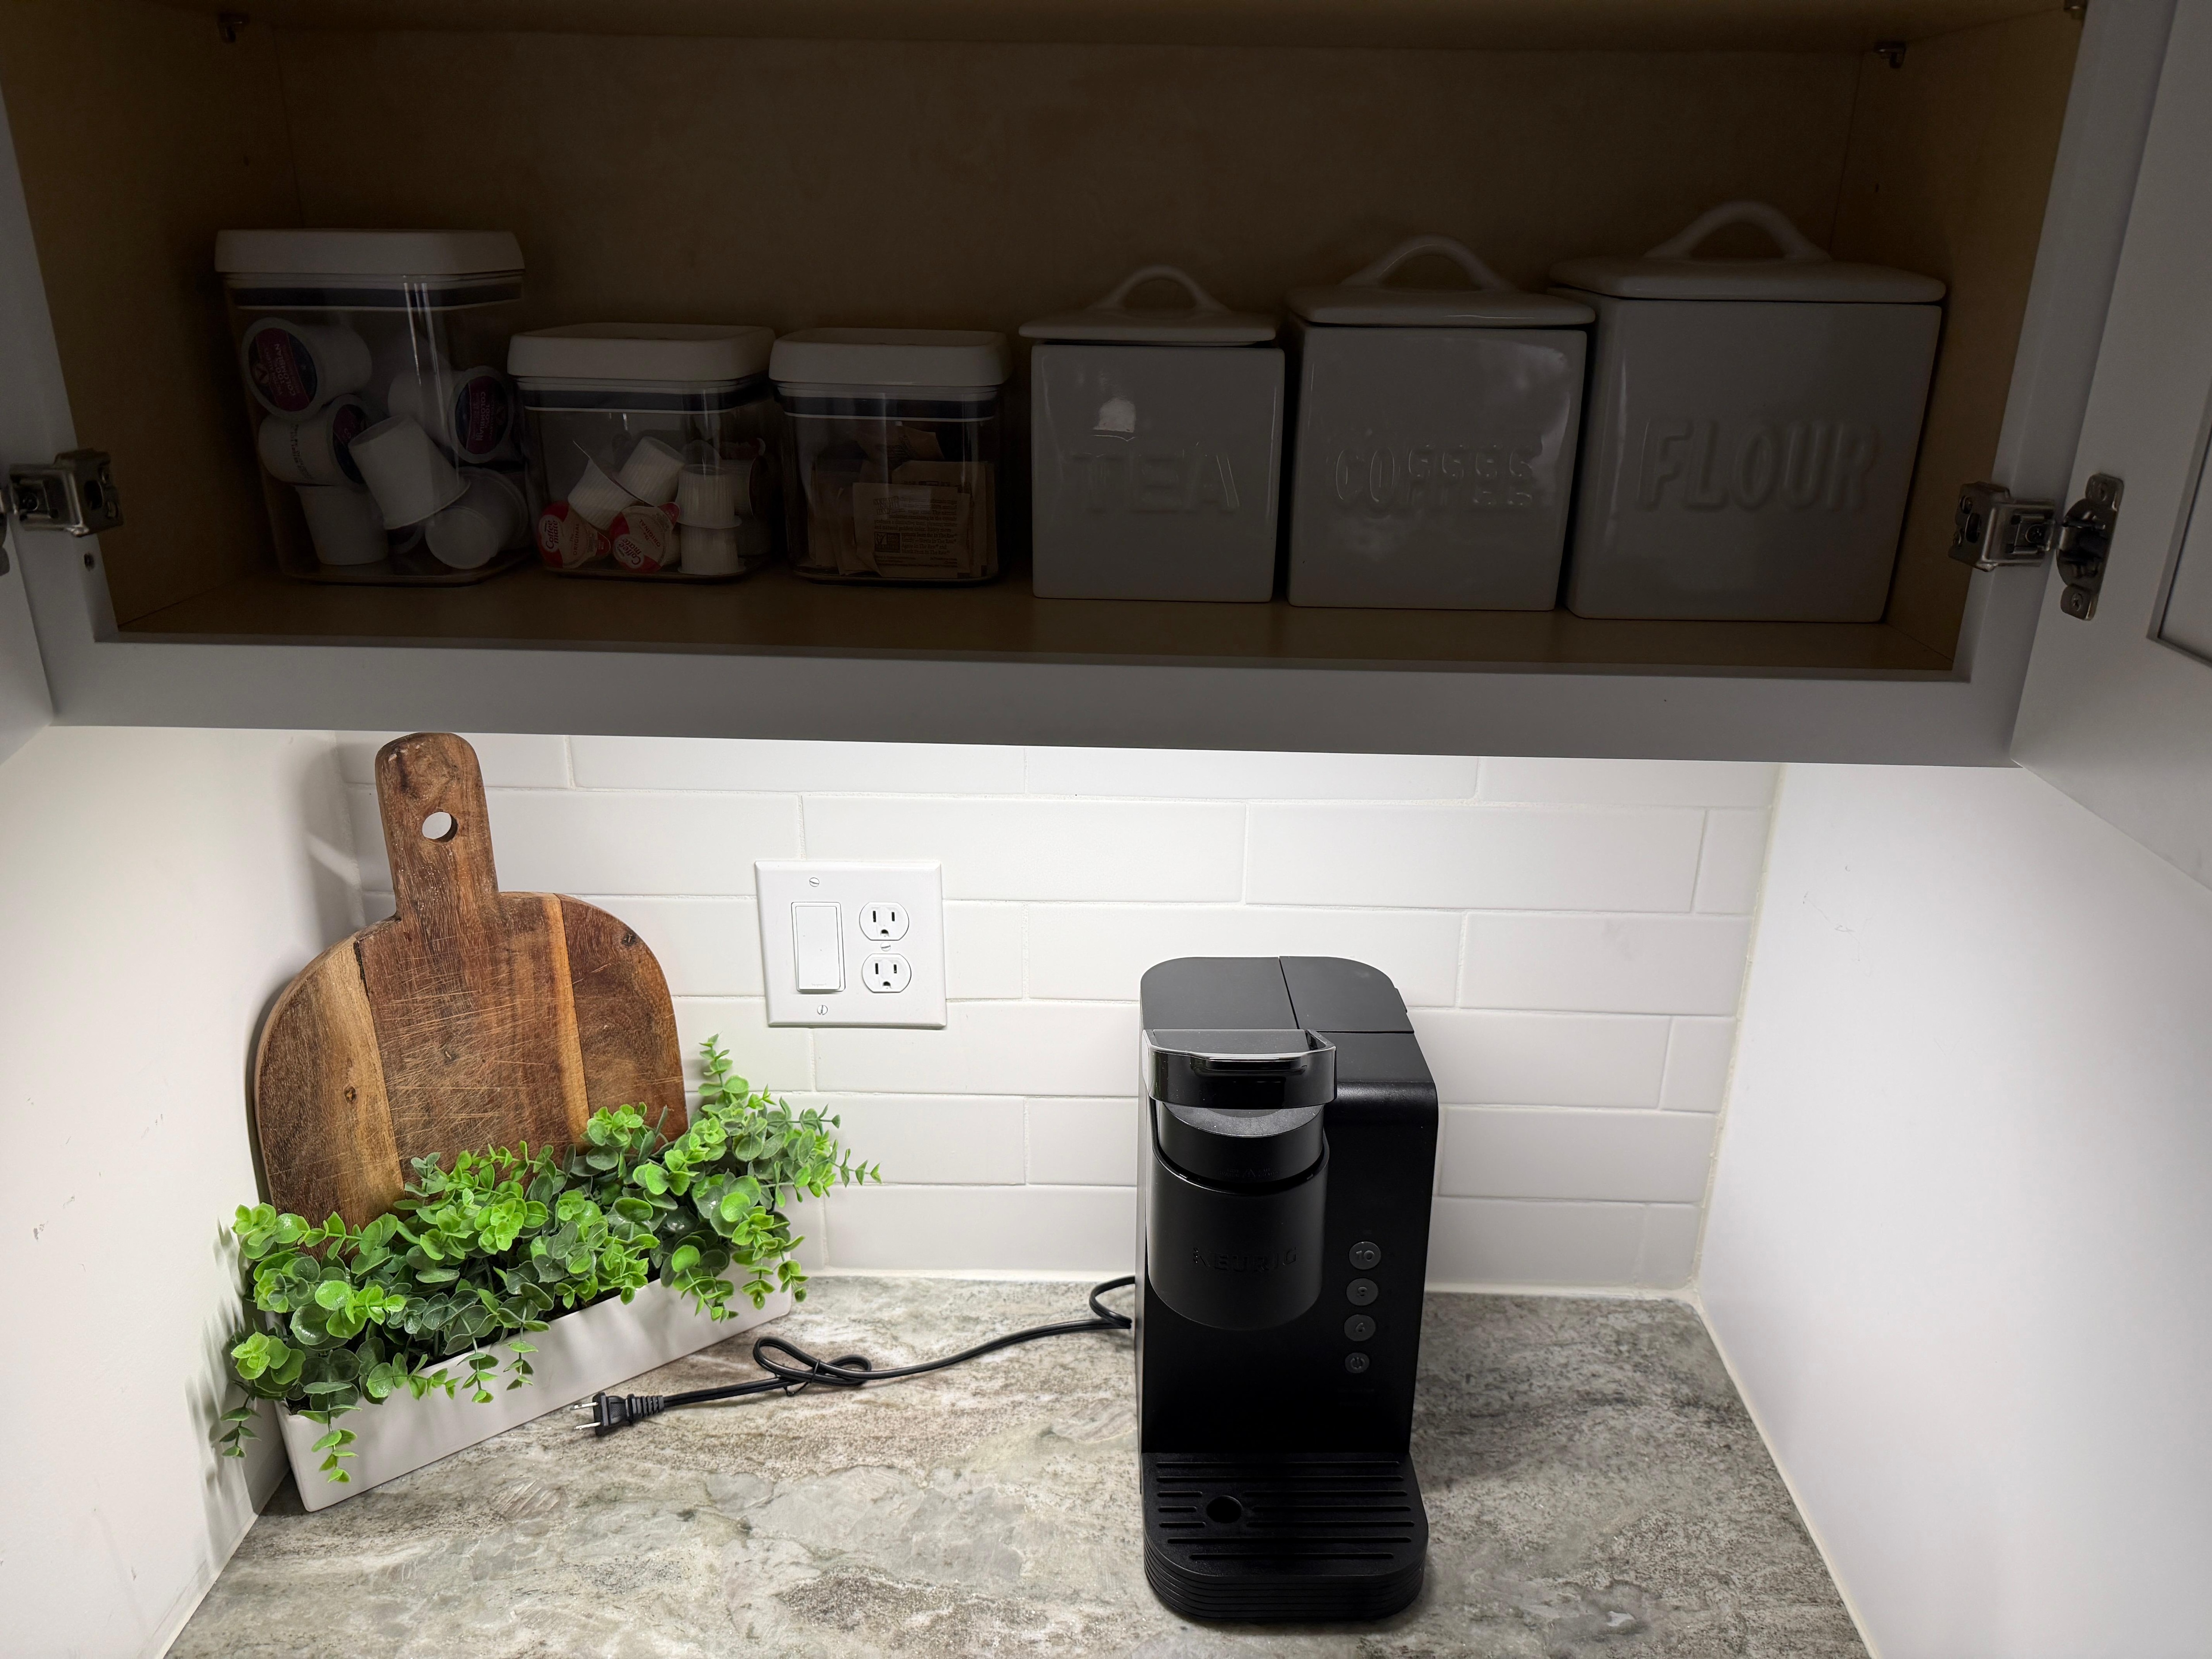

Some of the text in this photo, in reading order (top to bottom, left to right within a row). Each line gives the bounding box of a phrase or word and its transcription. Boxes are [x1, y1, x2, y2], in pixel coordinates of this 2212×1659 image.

[274, 344, 296, 396] COLOMBIAN
[476, 392, 486, 441] COLOMBIAN
[1335, 445, 1537, 511] COFFEE
[1637, 417, 1880, 512] FLOUR
[1071, 451, 1240, 515] TEA
[545, 520, 554, 549] Coffee
[622, 538, 642, 555] mate
[639, 519, 661, 547] ORIGINAL
[618, 541, 641, 565] Coffee
[1193, 1247, 1296, 1272] KEURIG
[1356, 1250, 1375, 1261] 10
[1356, 1322, 1366, 1333] 6
